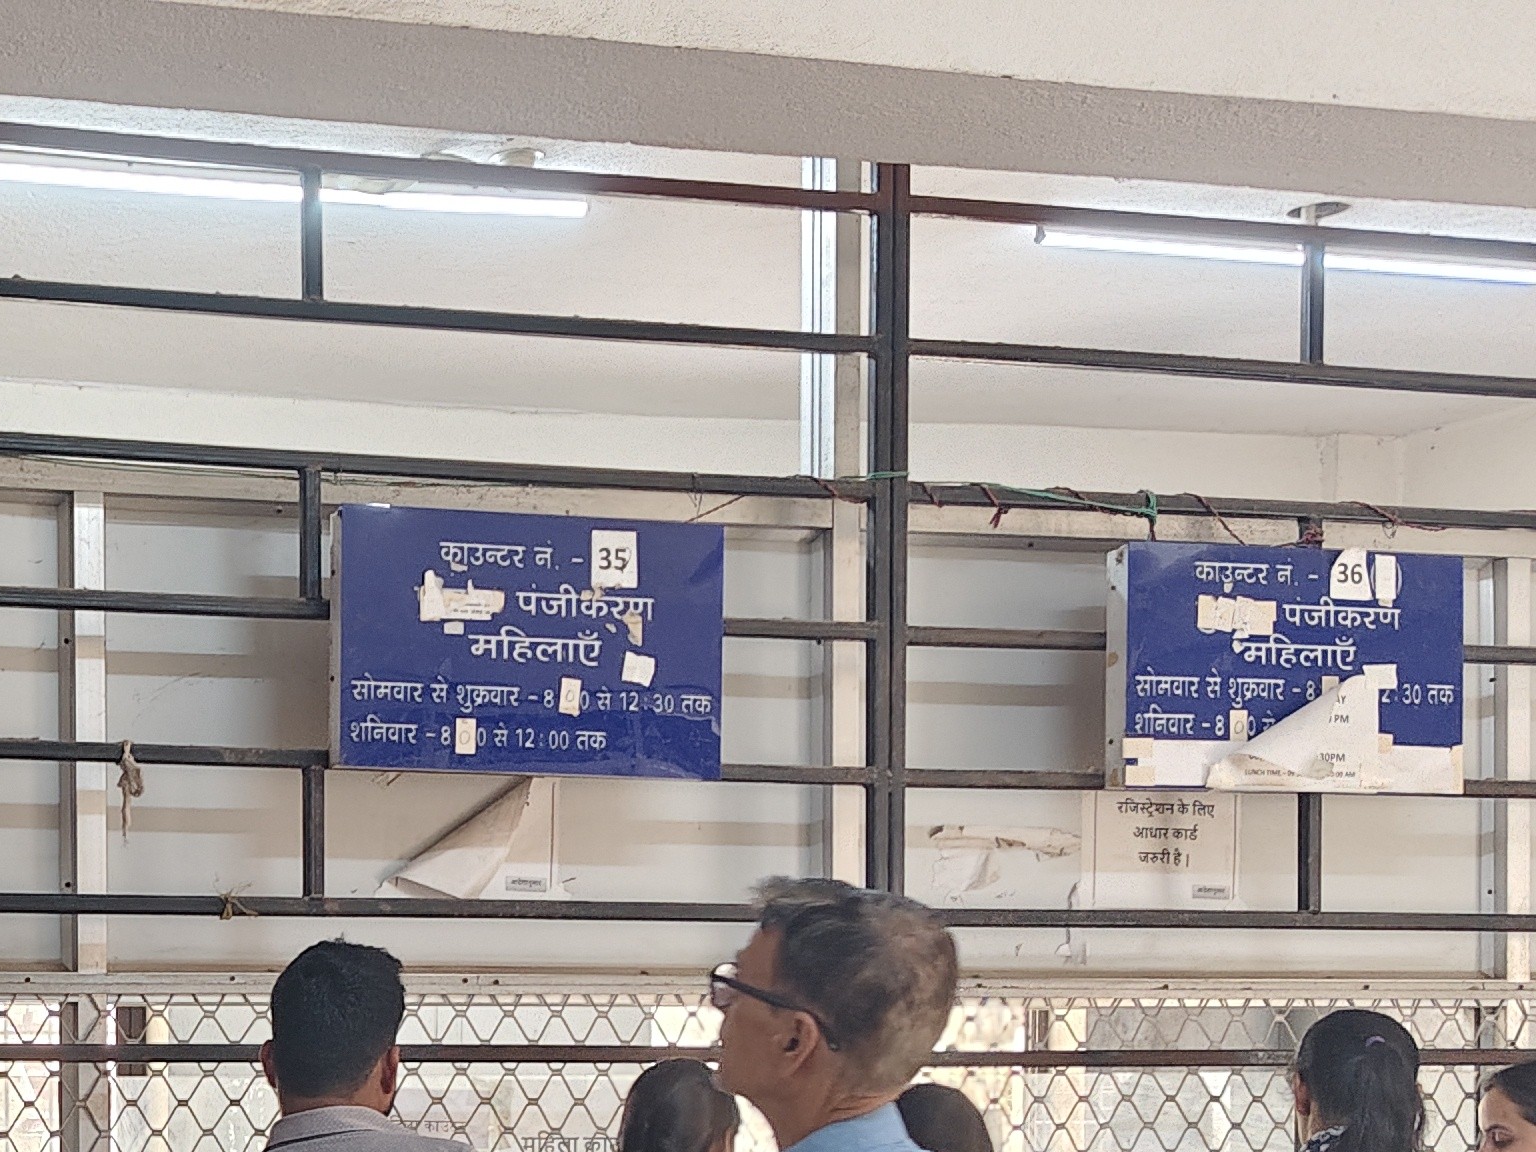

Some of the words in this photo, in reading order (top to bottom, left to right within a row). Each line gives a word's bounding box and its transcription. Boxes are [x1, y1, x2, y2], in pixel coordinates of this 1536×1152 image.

[439, 538, 525, 568] काउन्टर
[598, 546, 630, 573] 35
[1194, 561, 1270, 586] काउन्टर
[1336, 563, 1364, 585] 36
[515, 582, 656, 622] पंजीकरण
[1281, 596, 1402, 631] पंजीकरण
[467, 624, 604, 668] महिलाएँ
[1243, 633, 1357, 671] महिलाएँ
[351, 672, 424, 703] सोमवार
[429, 675, 449, 704] से
[456, 684, 521, 713] शुक्रवार
[595, 685, 612, 711] से
[620, 691, 675, 714] 12:30
[680, 693, 713, 715] तक
[1135, 666, 1201, 699] सोमवार
[1206, 667, 1222, 699] से
[1228, 677, 1286, 709] शुक्रवार
[1427, 684, 1455, 705] तक
[350, 713, 418, 744] शनिवार
[493, 721, 509, 747] से
[515, 729, 569, 750] 12:00
[575, 730, 607, 750] तक
[1135, 703, 1196, 735] शनिवार
[1116, 798, 1174, 818] रजिस्ट्रेशन
[1177, 798, 1190, 815] के
[1192, 800, 1216, 819] लिए
[1133, 826, 1169, 840] आधार
[1171, 823, 1199, 841] कार्ड
